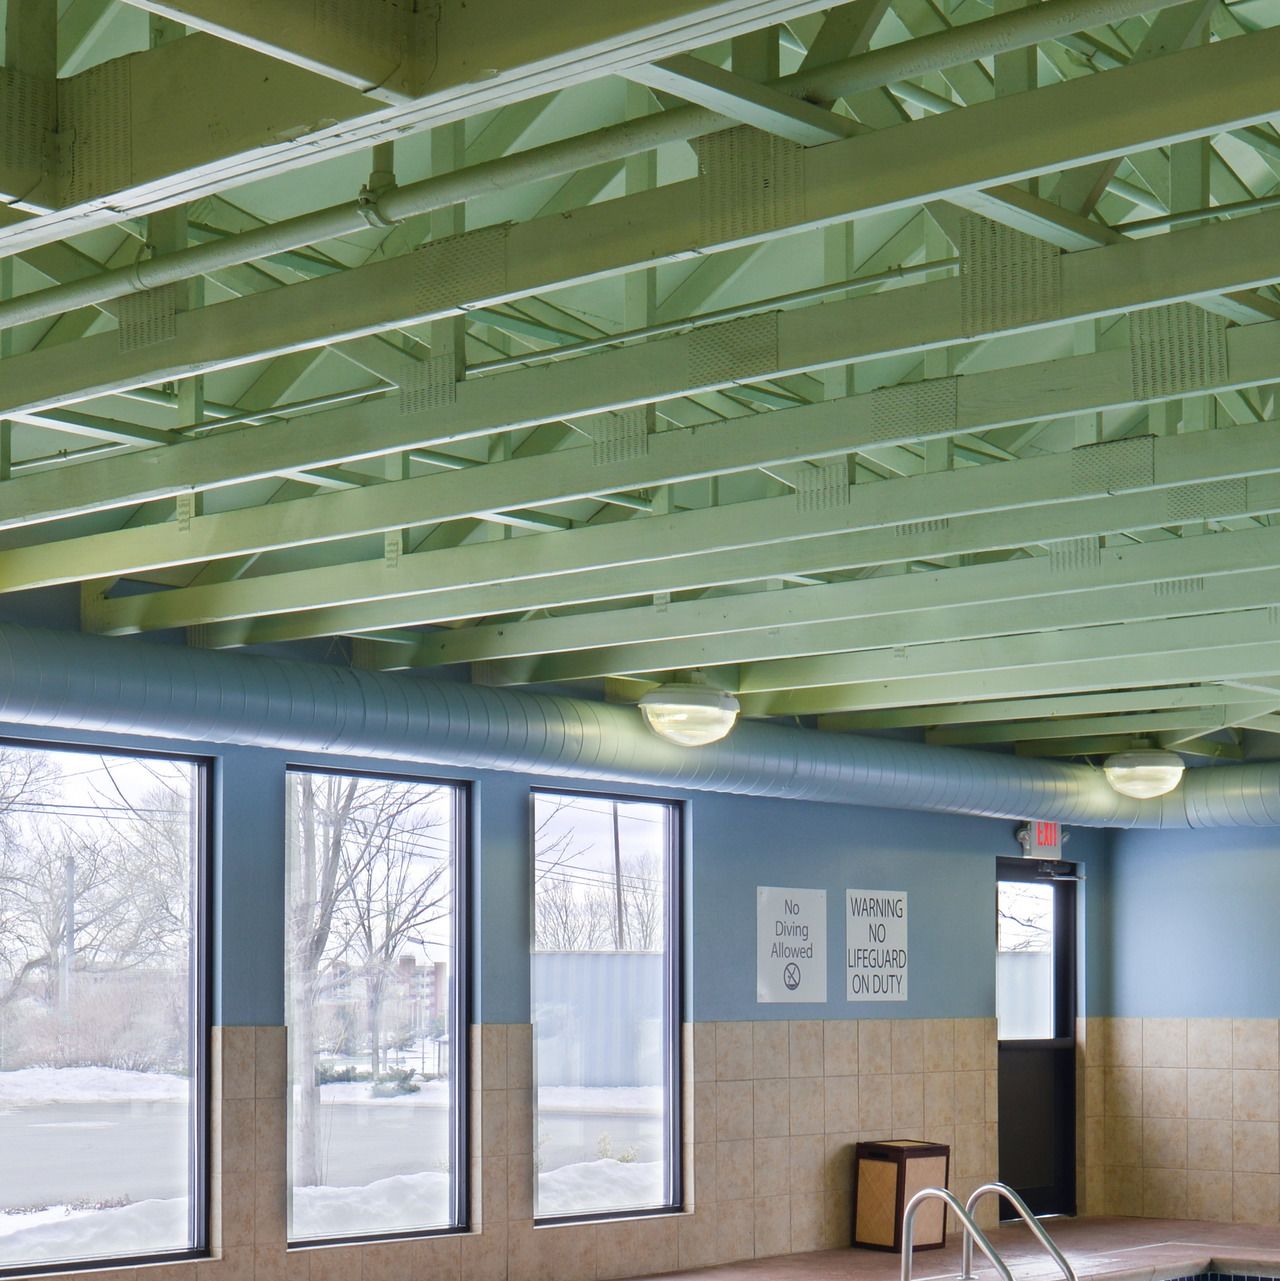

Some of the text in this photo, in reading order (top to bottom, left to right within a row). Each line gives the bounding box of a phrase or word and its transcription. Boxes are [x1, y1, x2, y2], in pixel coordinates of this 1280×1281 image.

[784, 899, 800, 915] No
[850, 897, 903, 918] WARNING
[775, 920, 809, 941] Diving
[869, 923, 886, 943] NO
[771, 941, 813, 959] Allowed
[848, 948, 907, 969] LIFEGUARD
[852, 974, 903, 994] ON DUTY
